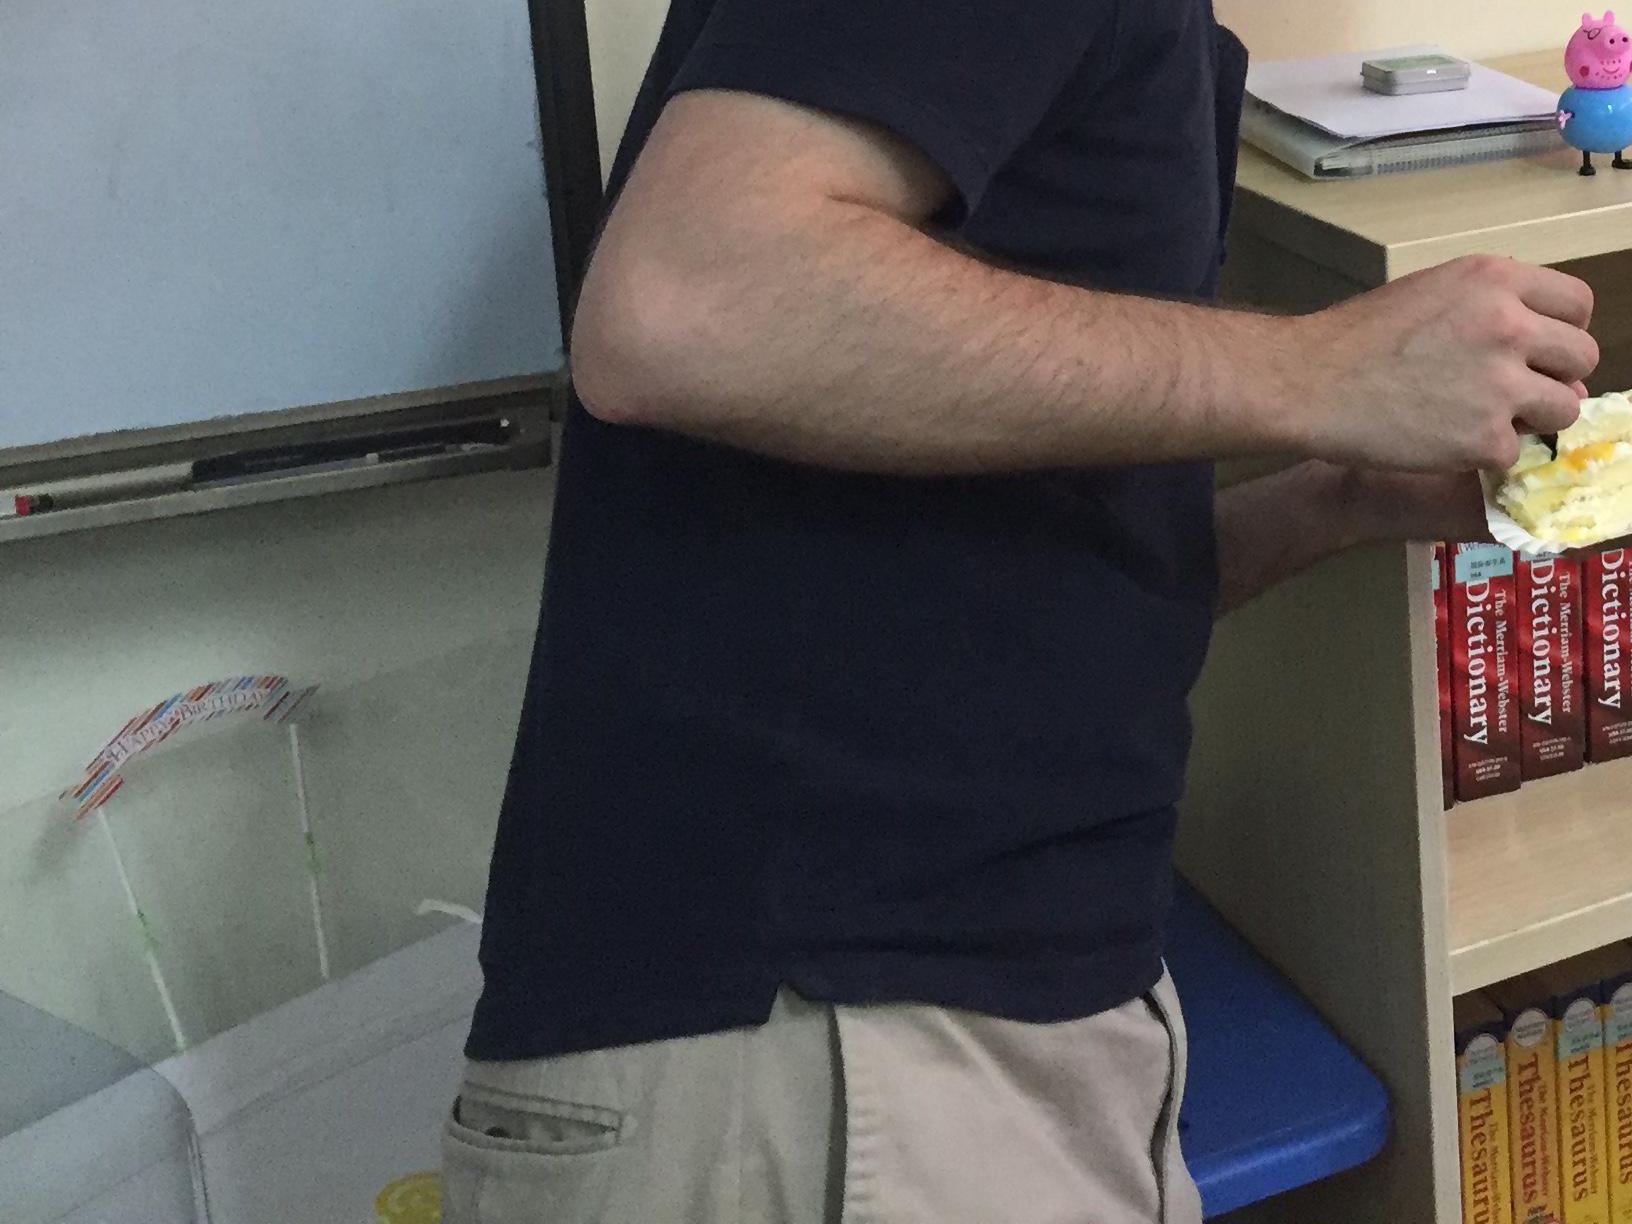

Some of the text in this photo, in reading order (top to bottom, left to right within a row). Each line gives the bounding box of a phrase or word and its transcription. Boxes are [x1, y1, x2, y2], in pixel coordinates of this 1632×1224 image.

[1463, 577, 1493, 745] Dictionary
[1494, 589, 1508, 734] The Merriam-Webster
[1527, 557, 1558, 725] Dictionary
[1559, 571, 1573, 714] The Merriam-Webster
[1597, 548, 1626, 709] Dictionary
[1470, 1087, 1494, 1224] Thesauru
[1518, 1051, 1542, 1205] Thesaurus
[1568, 1055, 1591, 1203] Thesaurus
